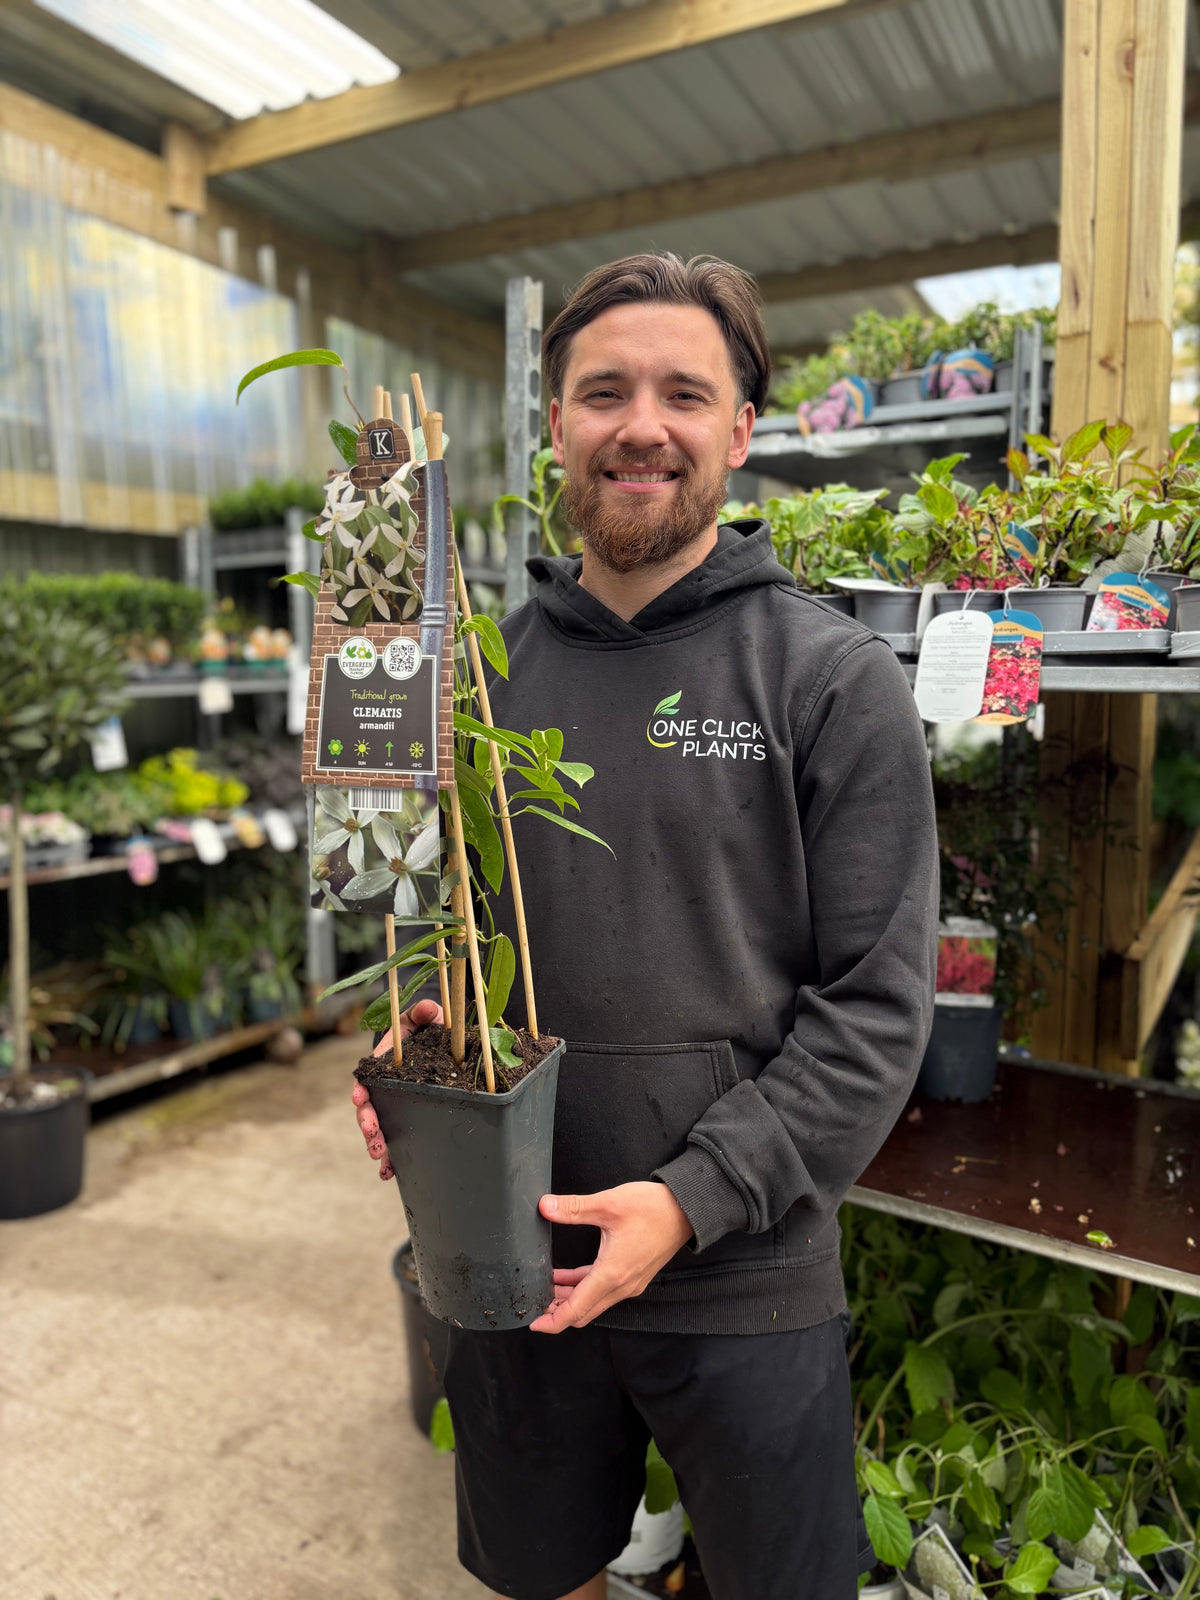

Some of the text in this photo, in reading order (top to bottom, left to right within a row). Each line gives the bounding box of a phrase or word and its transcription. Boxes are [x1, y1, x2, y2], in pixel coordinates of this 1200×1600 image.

[373, 431, 391, 455] K
[350, 689, 408, 704] Traditional grown
[353, 707, 402, 718] CLEMATIS
[359, 721, 395, 730] armandii
[653, 719, 765, 740] ONE CLICK
[682, 740, 767, 761] PLANTS
